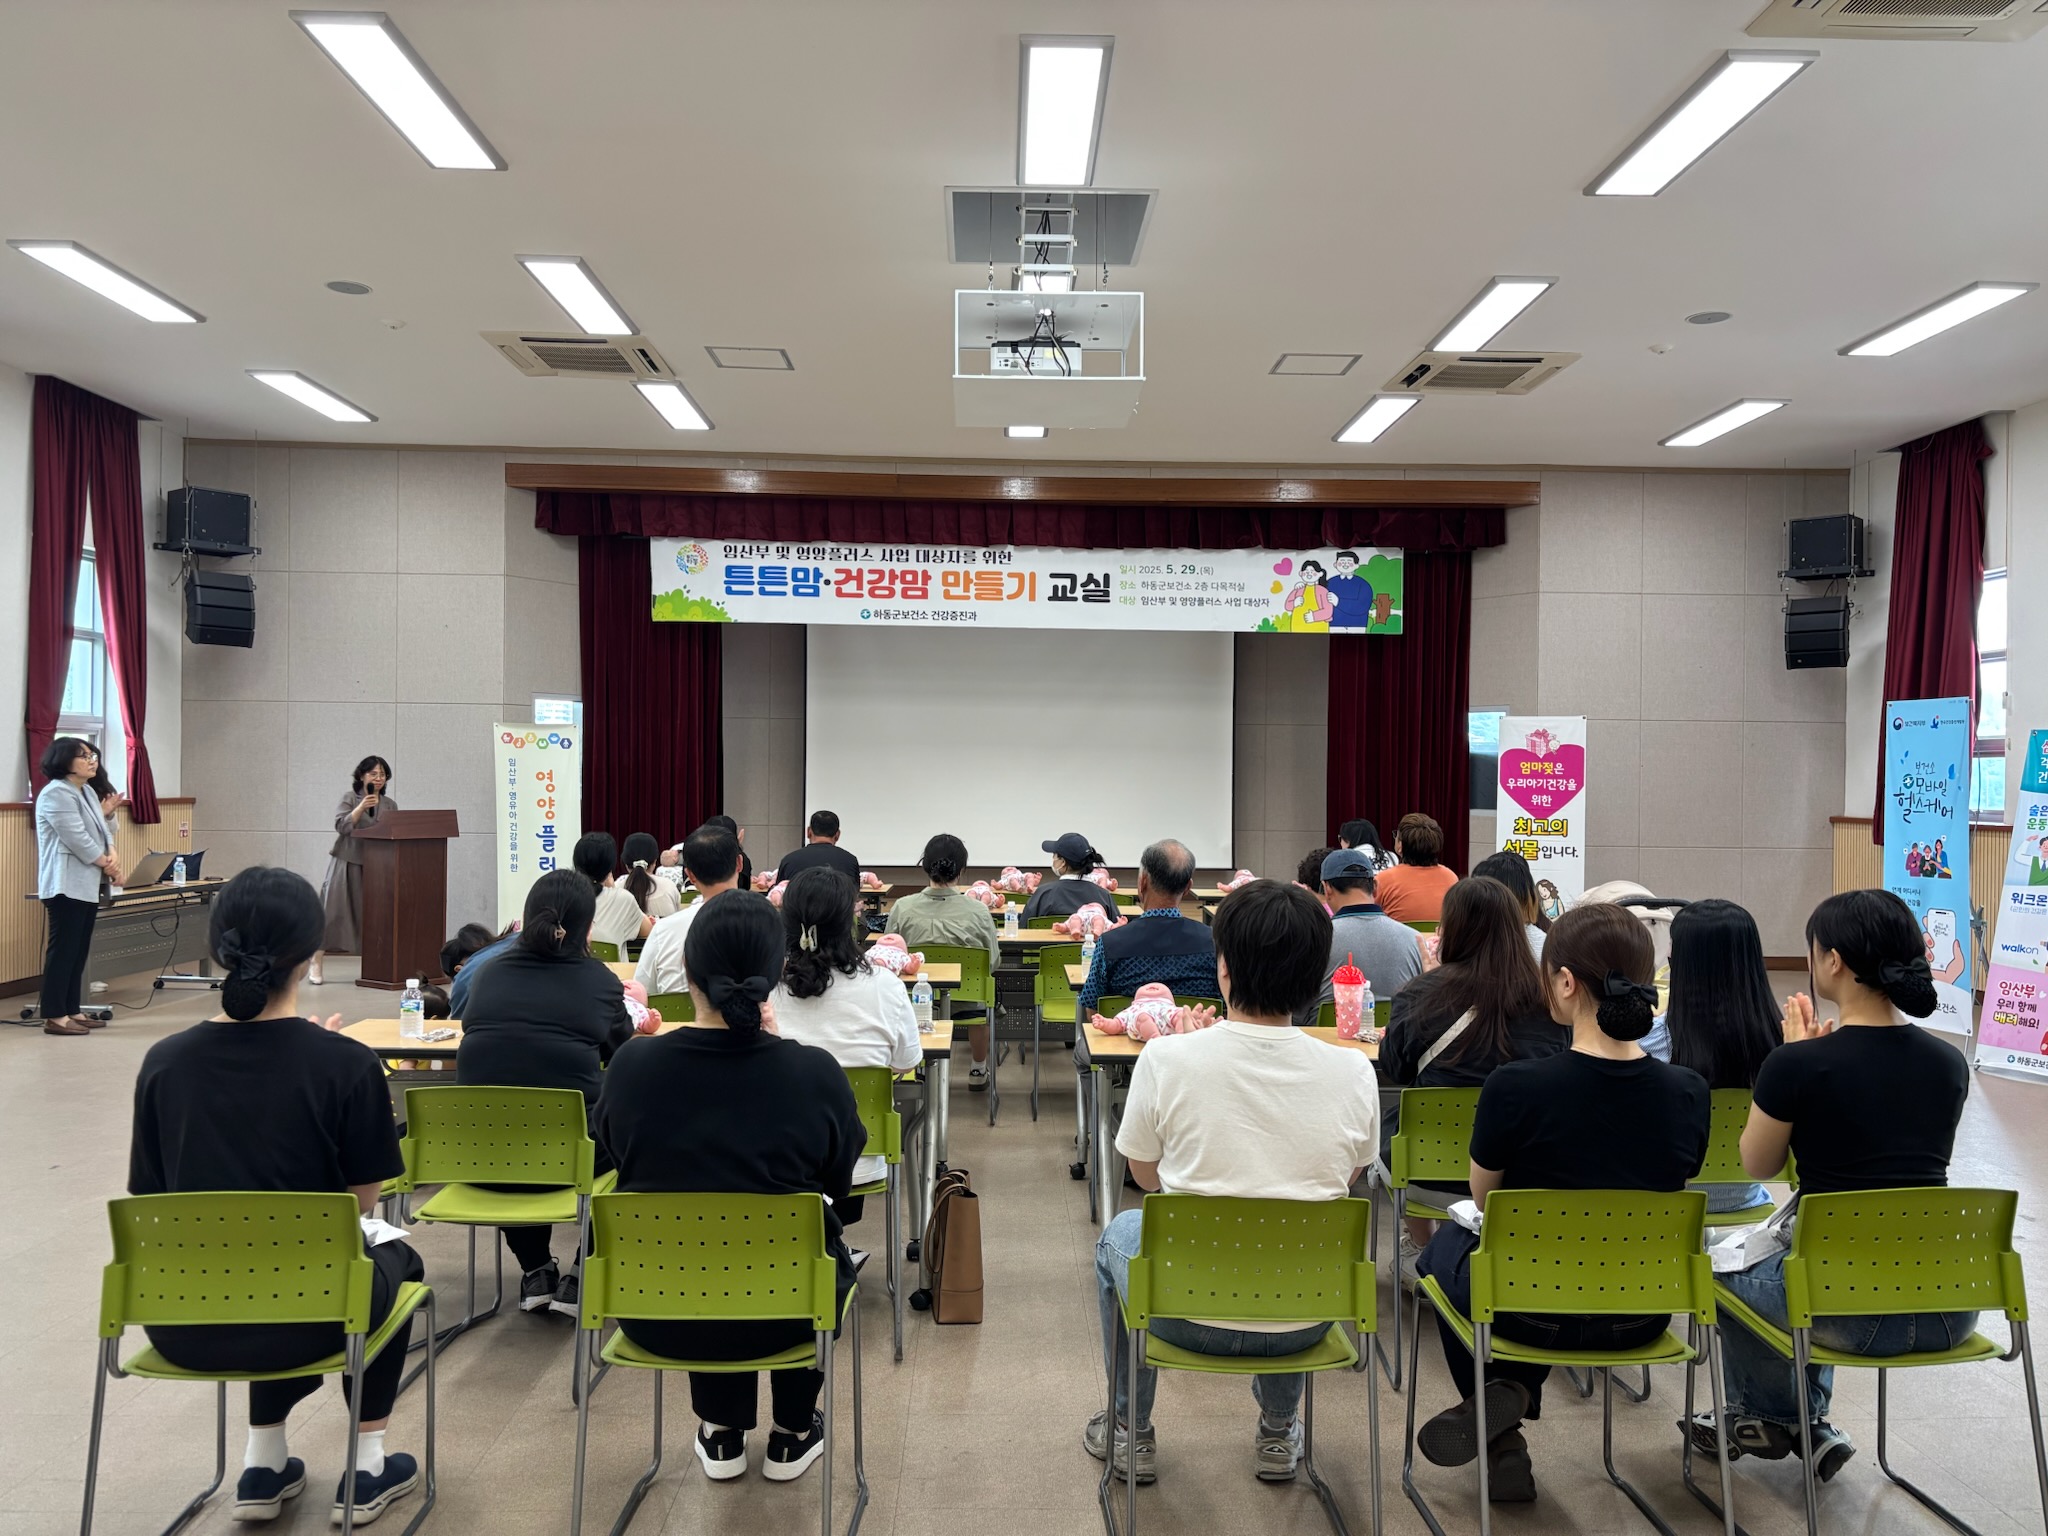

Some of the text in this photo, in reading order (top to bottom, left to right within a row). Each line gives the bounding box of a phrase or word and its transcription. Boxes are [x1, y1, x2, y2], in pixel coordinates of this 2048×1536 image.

[723, 545, 1013, 565] 임산부 및 영양플러스 사업 대상자를 위한
[1119, 564, 1136, 574] 일시
[1139, 565, 1164, 575] 2025.
[1166, 564, 1177, 575] 5.
[941, 569, 1037, 602] 만들기
[1047, 571, 1112, 604] 교실
[1119, 581, 1246, 592] 장소 하동군보건소 2층 다목적실
[1119, 596, 1270, 608] 대상 임산부 및 영양플러스 사업 대상자
[873, 609, 977, 622] 하동군보건소 건강증진과
[1520, 762, 1565, 775] 엄마젖은
[1915, 761, 1936, 775] 보건소
[1506, 778, 1577, 791] 우리아기건강을
[1916, 778, 1947, 797] 모바일
[1531, 794, 1552, 807] 위한
[1893, 786, 1953, 824] 헬스케어
[1513, 817, 1568, 838] 최고의
[509, 822, 518, 851] 건강을
[510, 853, 518, 872] 위한
[2010, 892, 2048, 907] 워크온
[2001, 943, 2039, 955] walkon
[1999, 980, 2036, 999] 임산부
[1996, 998, 2037, 1013] 우리 함께
[1993, 1011, 2040, 1030] 배려해요!
